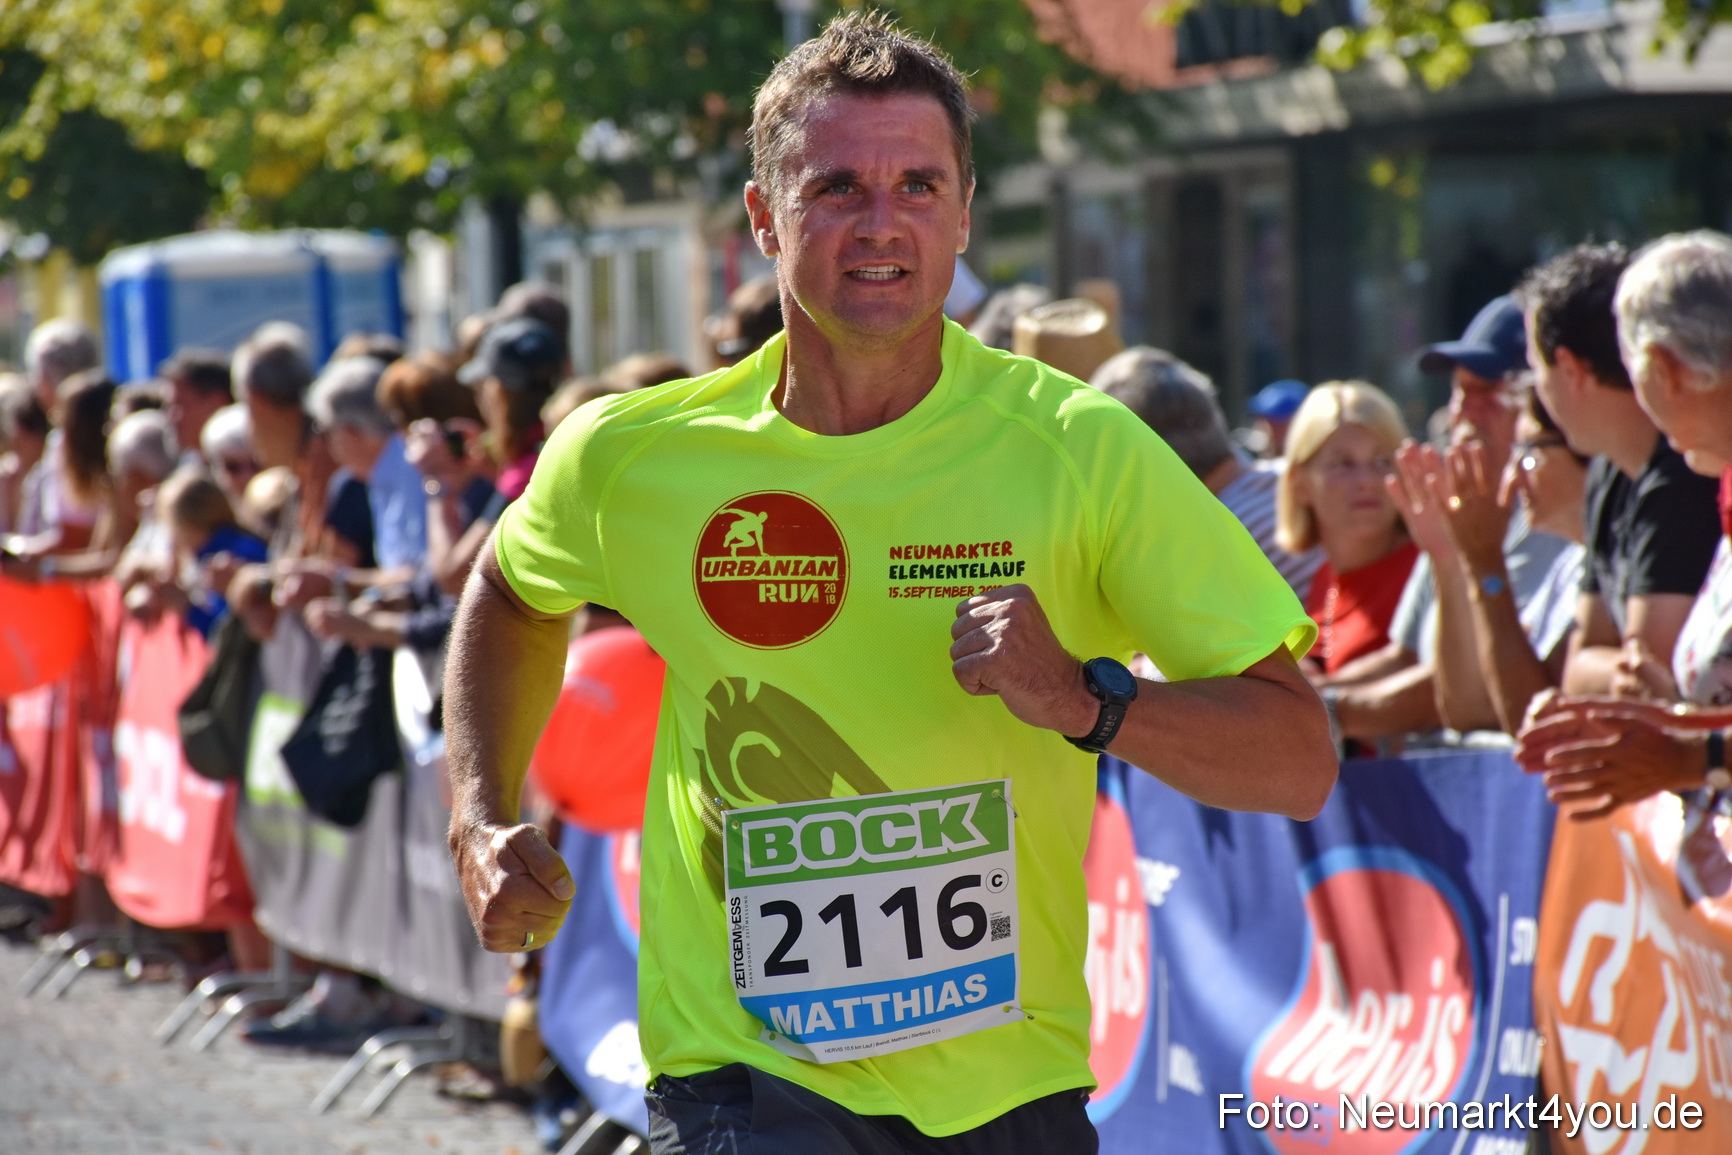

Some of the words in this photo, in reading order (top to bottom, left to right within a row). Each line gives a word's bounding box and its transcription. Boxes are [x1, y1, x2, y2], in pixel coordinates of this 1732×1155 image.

[889, 540, 1013, 560] NEUMARKTER
[703, 559, 837, 578] URBANIAN
[889, 560, 1026, 580] ELEMENTELAUF
[758, 583, 819, 603] RUN
[824, 582, 837, 594] 20
[825, 594, 837, 605] 18
[888, 585, 974, 599] 15.SEPTEMBER
[742, 792, 991, 877] BOCK
[991, 874, 1003, 888] C
[760, 874, 988, 977] 2116
[769, 973, 988, 1036] MATTHIAS
[1264, 941, 1467, 1133] hervis
